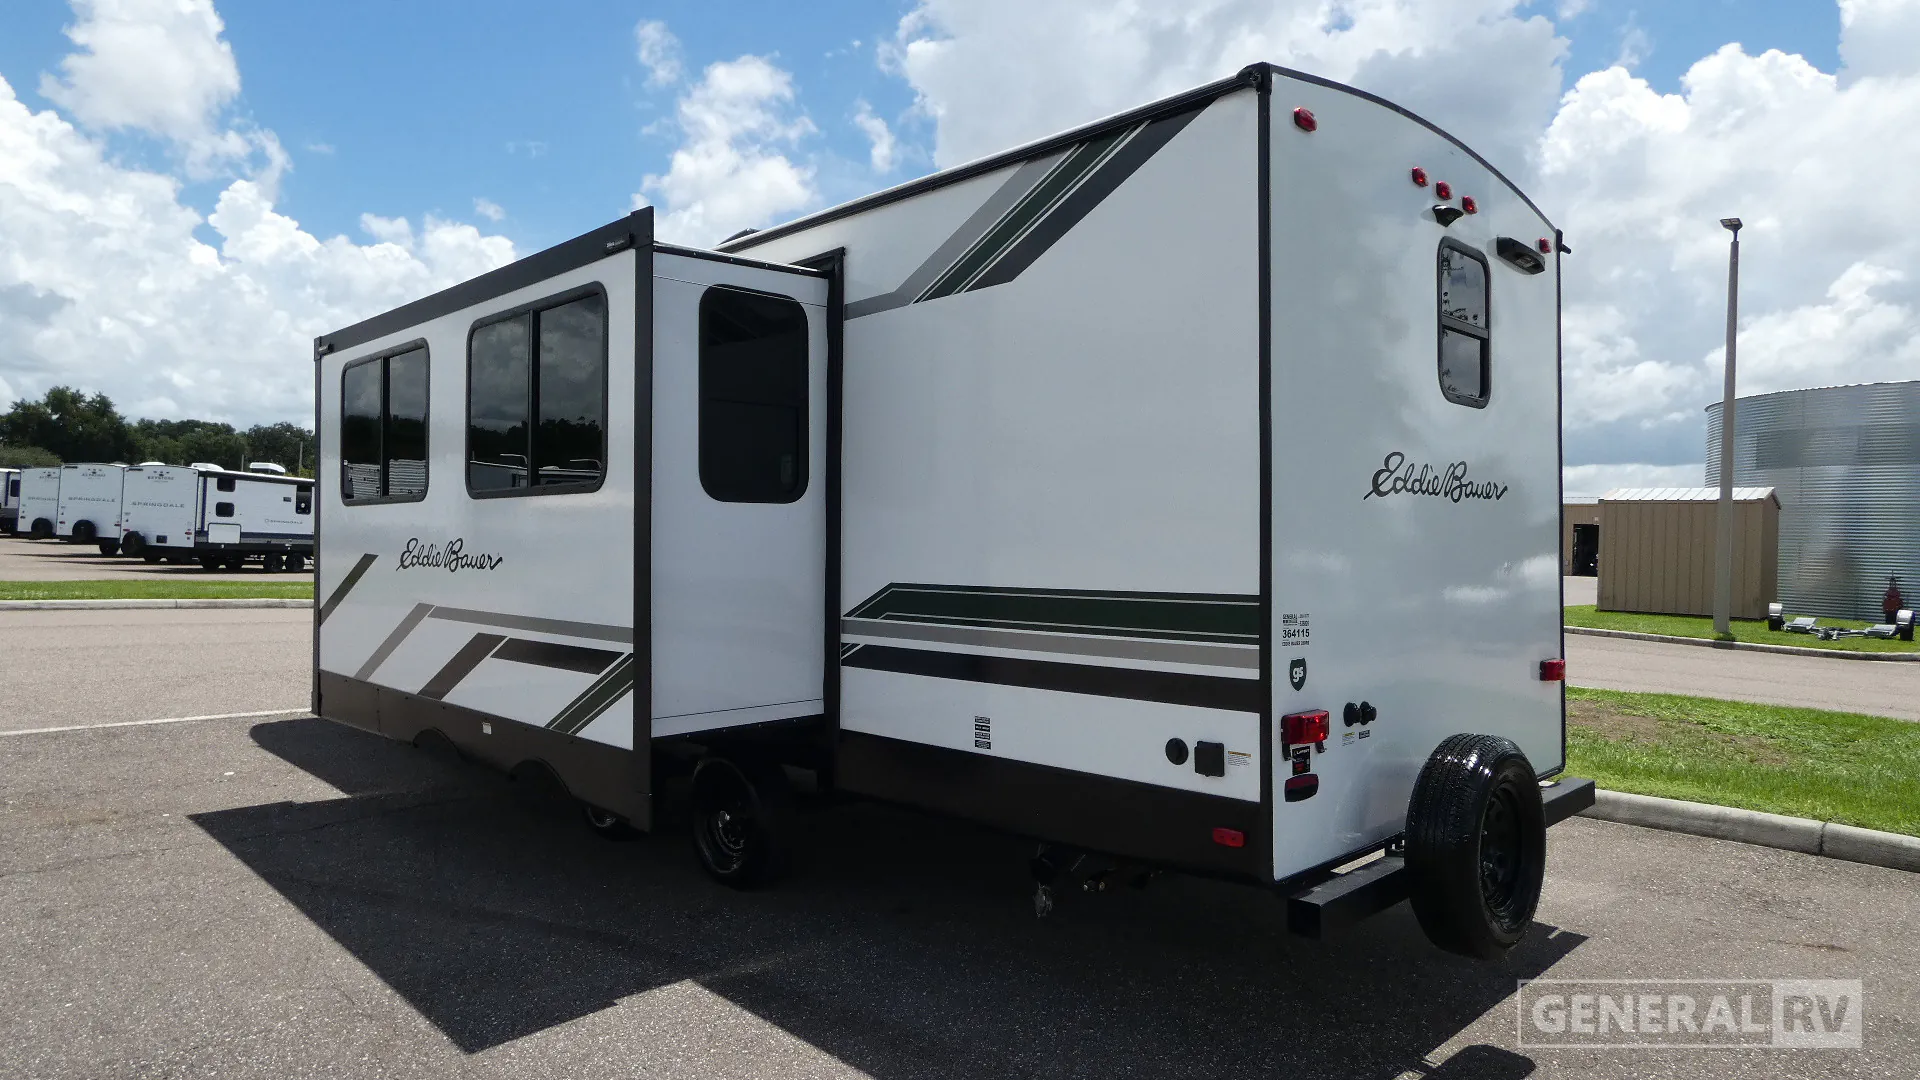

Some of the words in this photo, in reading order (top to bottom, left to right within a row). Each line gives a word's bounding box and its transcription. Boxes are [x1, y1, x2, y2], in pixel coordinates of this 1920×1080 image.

[1363, 451, 1442, 500] Eddie
[1442, 460, 1508, 503] Bauer
[131, 501, 185, 509] SPRINGDALE
[396, 537, 443, 571] Eddie
[443, 537, 503, 573] Bauer
[1282, 628, 1310, 639] 364115
